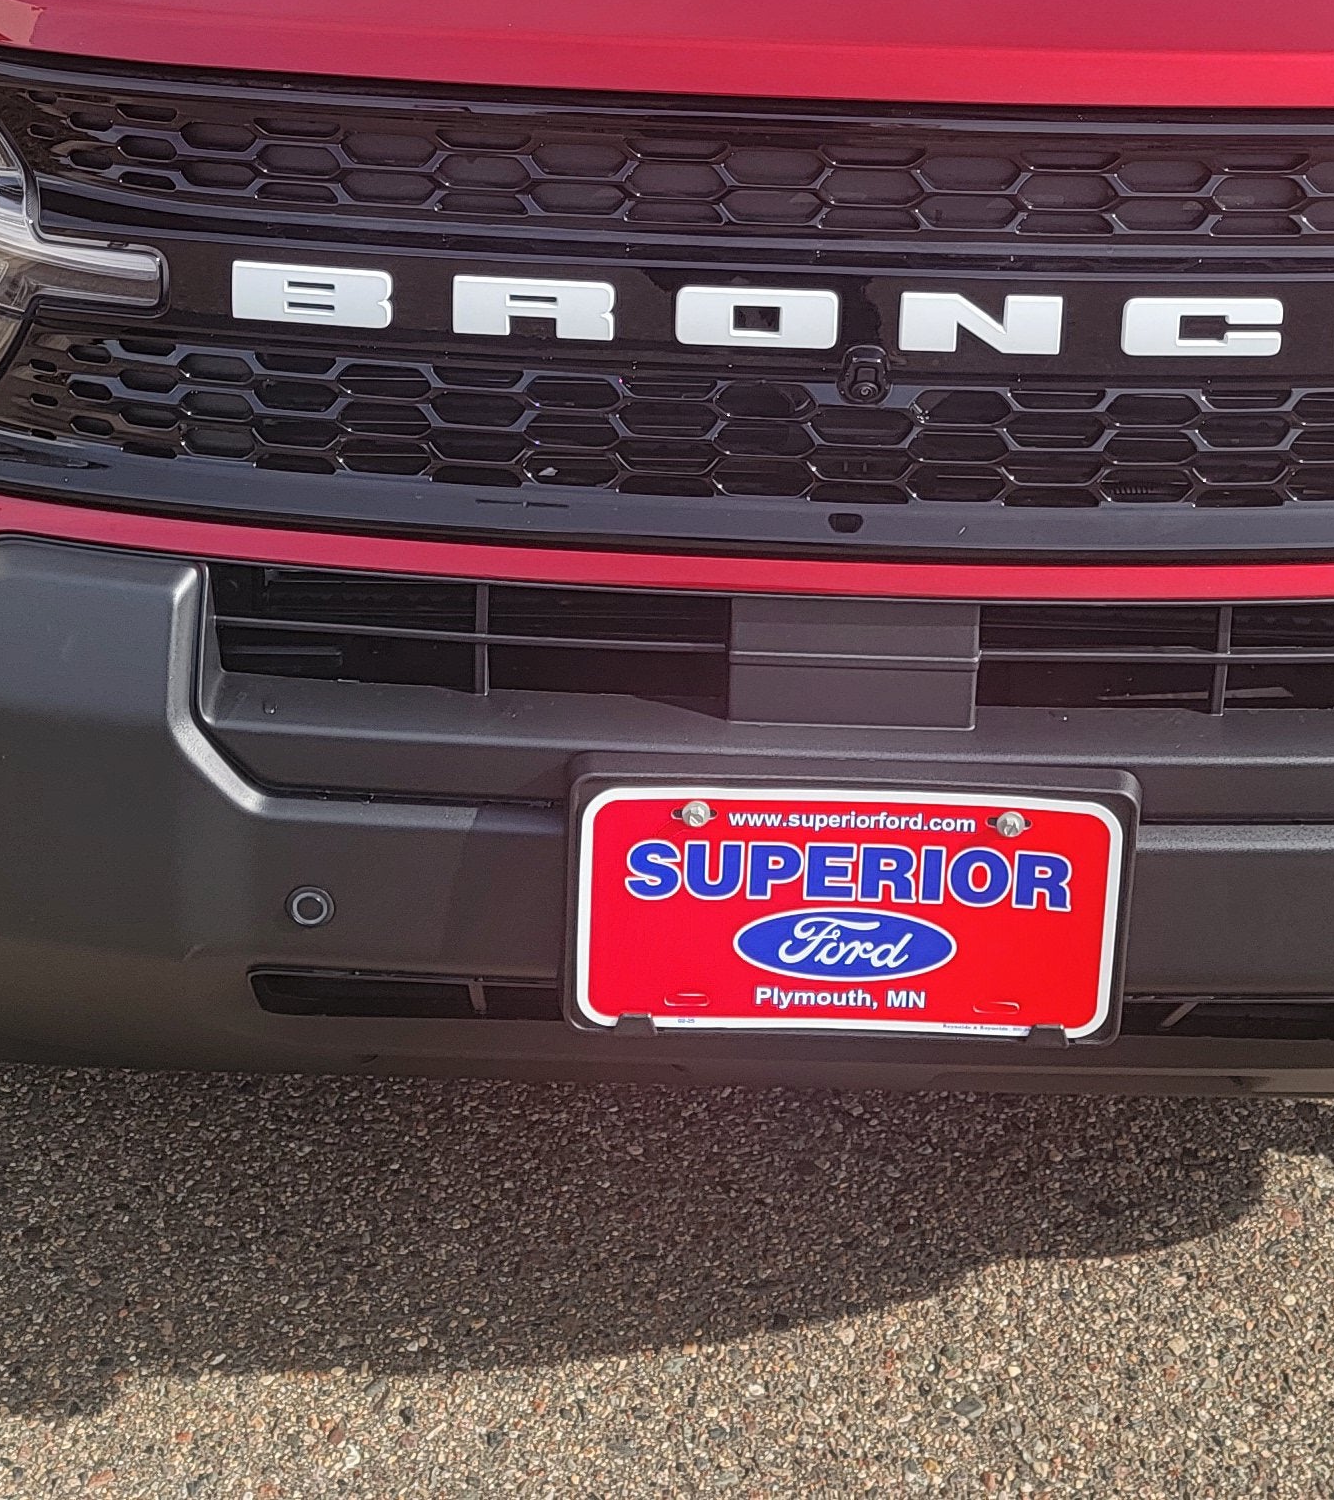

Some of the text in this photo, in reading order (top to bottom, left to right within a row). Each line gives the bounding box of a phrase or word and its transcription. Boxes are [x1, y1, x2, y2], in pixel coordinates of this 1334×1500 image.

[728, 811, 976, 833] www.superiorford.com
[624, 839, 1072, 912] SUPERIOR
[778, 916, 914, 968] Ford
[755, 987, 926, 1009] Plymouth, MN
